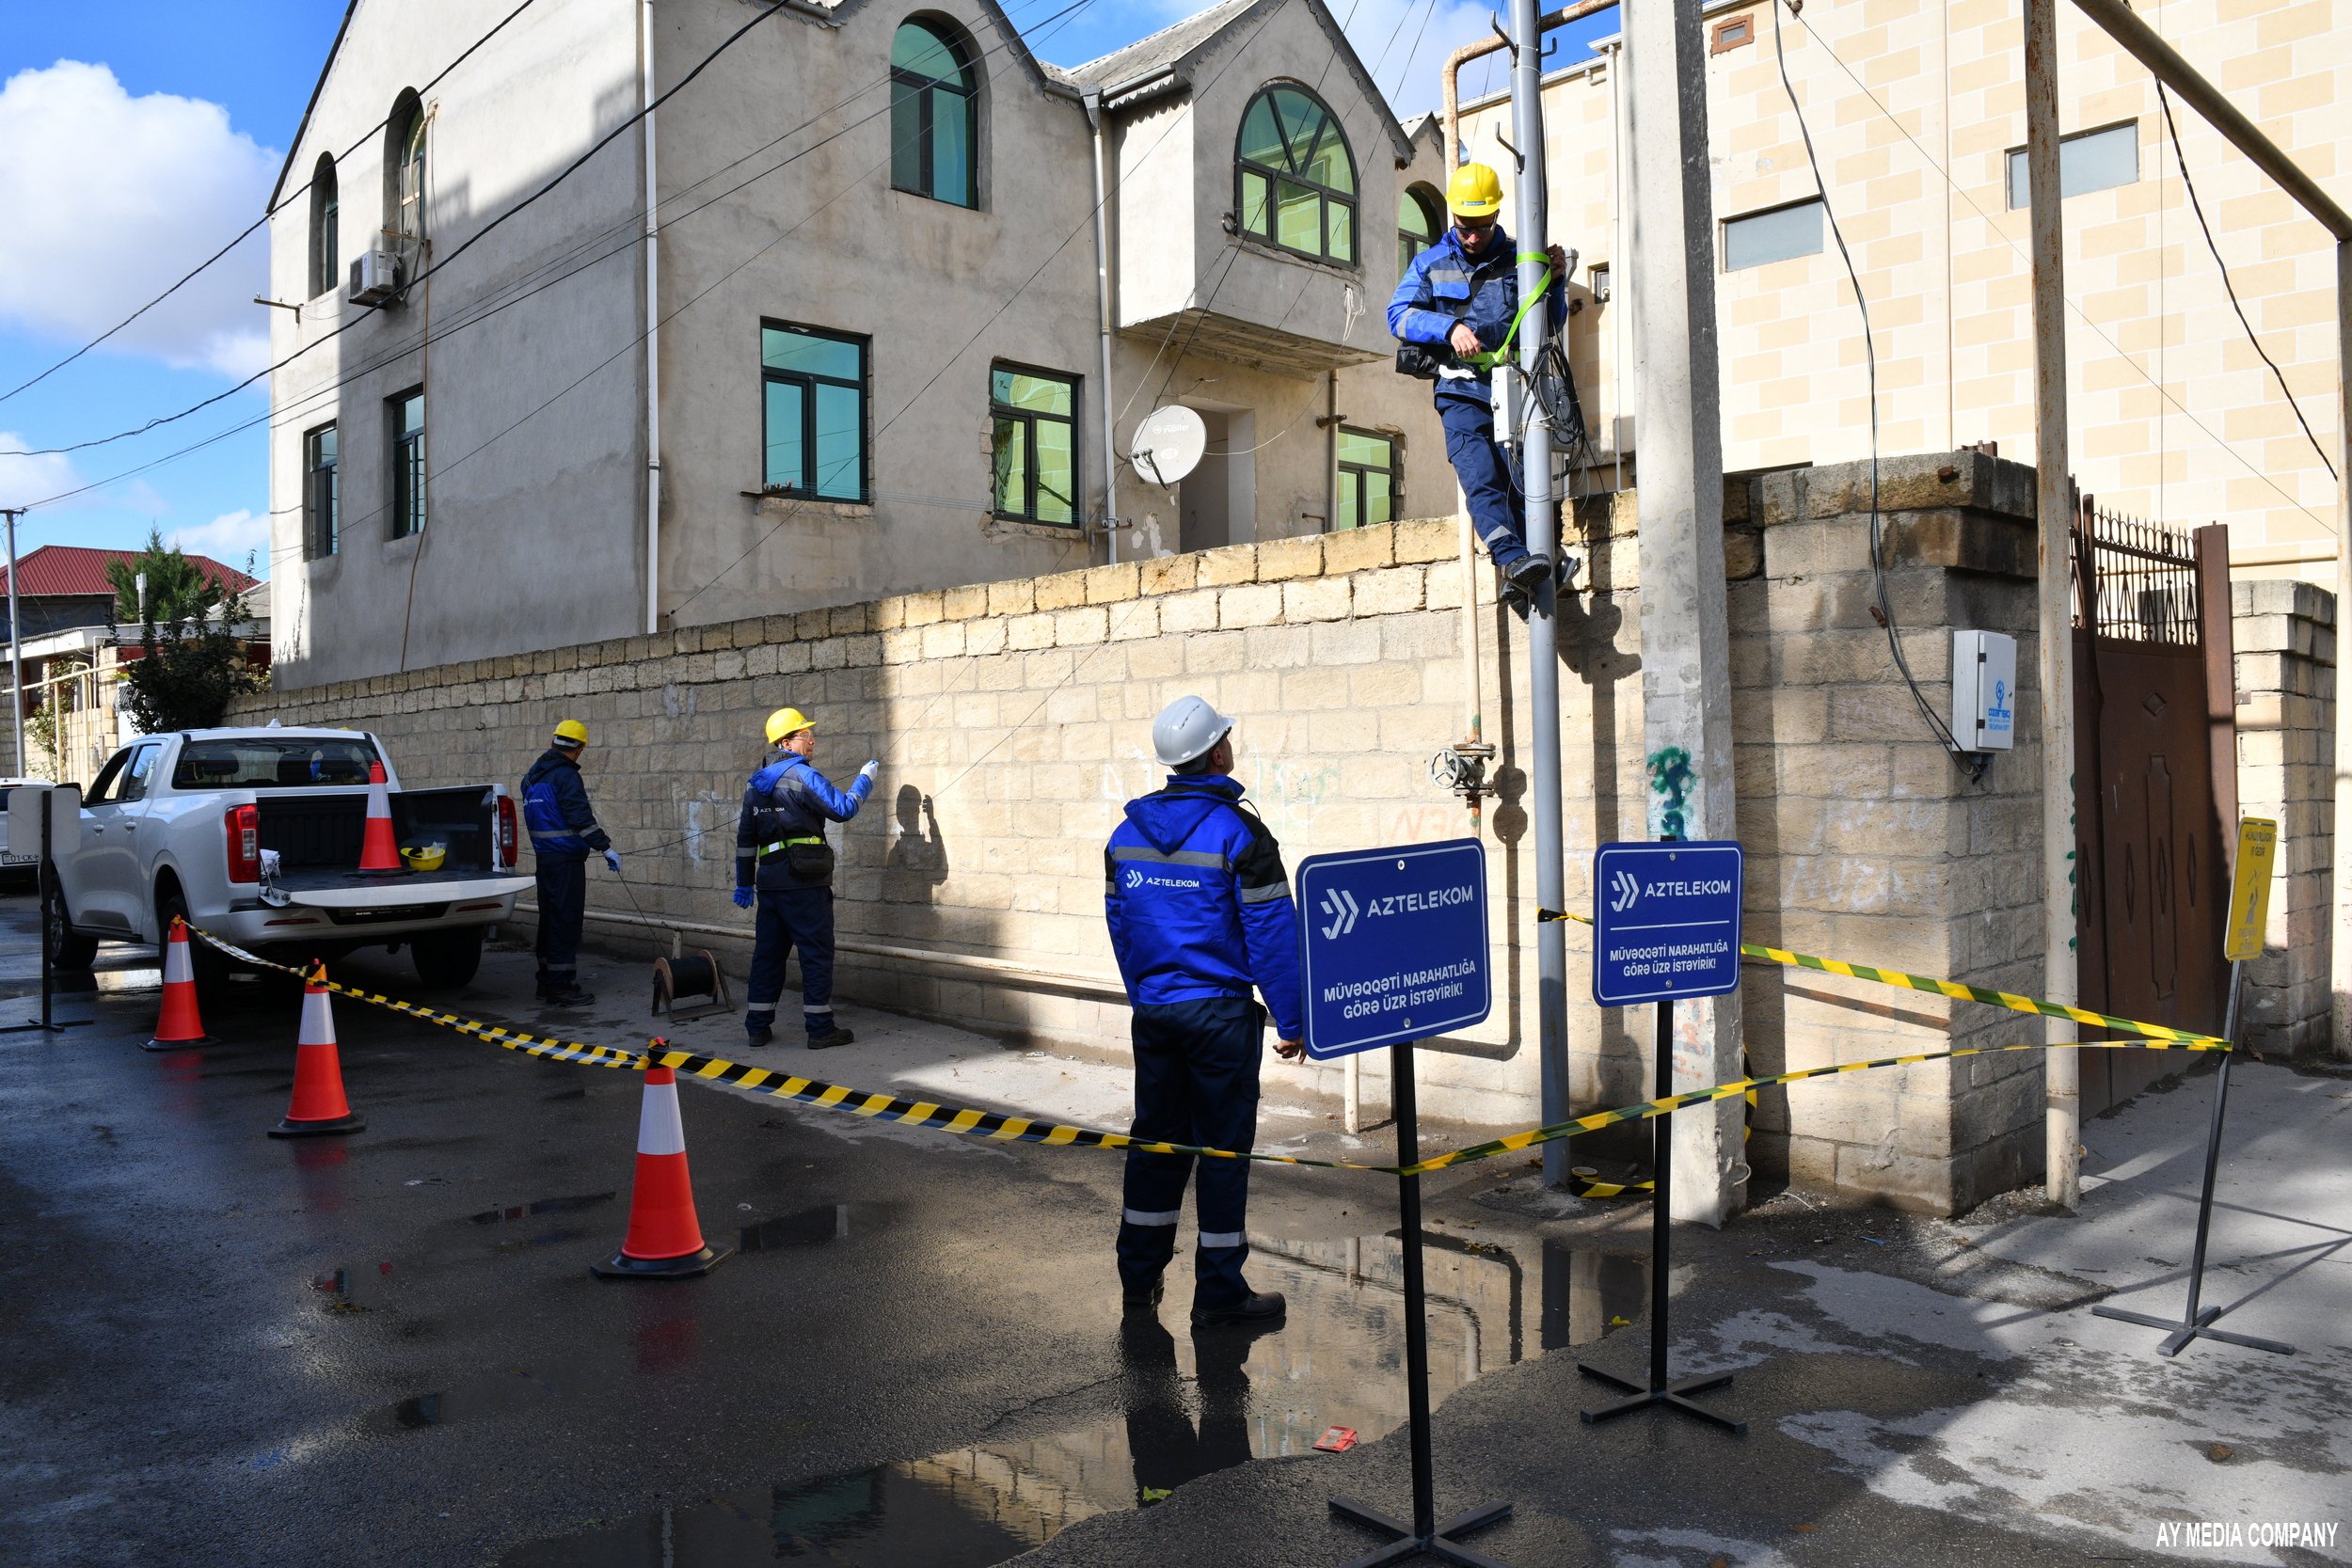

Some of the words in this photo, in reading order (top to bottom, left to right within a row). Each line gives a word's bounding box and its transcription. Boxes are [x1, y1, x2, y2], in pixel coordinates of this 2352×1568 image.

[1146, 877, 1200, 888] AZTELEKOM
[1645, 879, 1731, 897] AZTELEKOM
[1367, 885, 1473, 918] AZTELEKOM
[1610, 943, 1666, 961] MÜVƏQQƏTİ
[1668, 939, 1728, 957] NARAHATLIĞA
[1623, 959, 1650, 976] GÖRƏ
[1652, 959, 1670, 974] ÜZR
[1673, 956, 1716, 973] İSTƏYİRİK!
[1324, 973, 1400, 1003] MÜVƏQQƏTİ
[1403, 958, 1476, 987] NARAHATLIĞA
[1343, 1000, 1379, 1019] GÖRƏ
[1383, 993, 1406, 1011] ÜZR
[1409, 982, 1463, 1006] İSTƏYİRİK!
